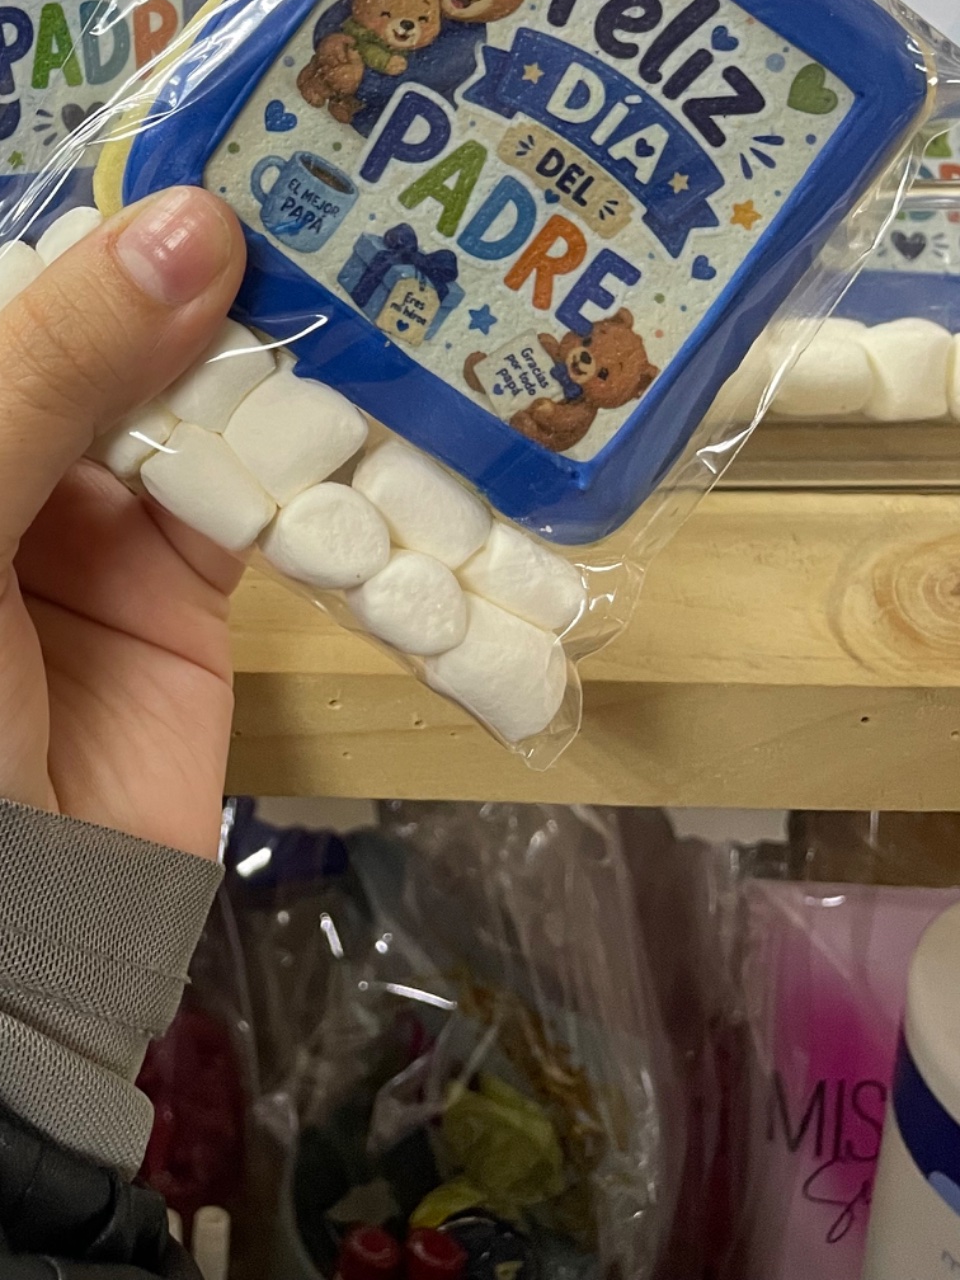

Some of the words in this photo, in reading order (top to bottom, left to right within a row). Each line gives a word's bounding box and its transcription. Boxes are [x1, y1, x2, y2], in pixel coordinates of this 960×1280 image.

[544, 61, 678, 186] DÍA
[288, 178, 301, 195] EL
[301, 188, 340, 218] MEJOR
[534, 146, 598, 208] DEL
[280, 196, 327, 234] PAPÁ
[359, 88, 643, 339] PADRE
[495, 367, 524, 397] papá
[503, 353, 522, 370] por
[518, 371, 537, 396] todo
[521, 347, 549, 389] Gracias
